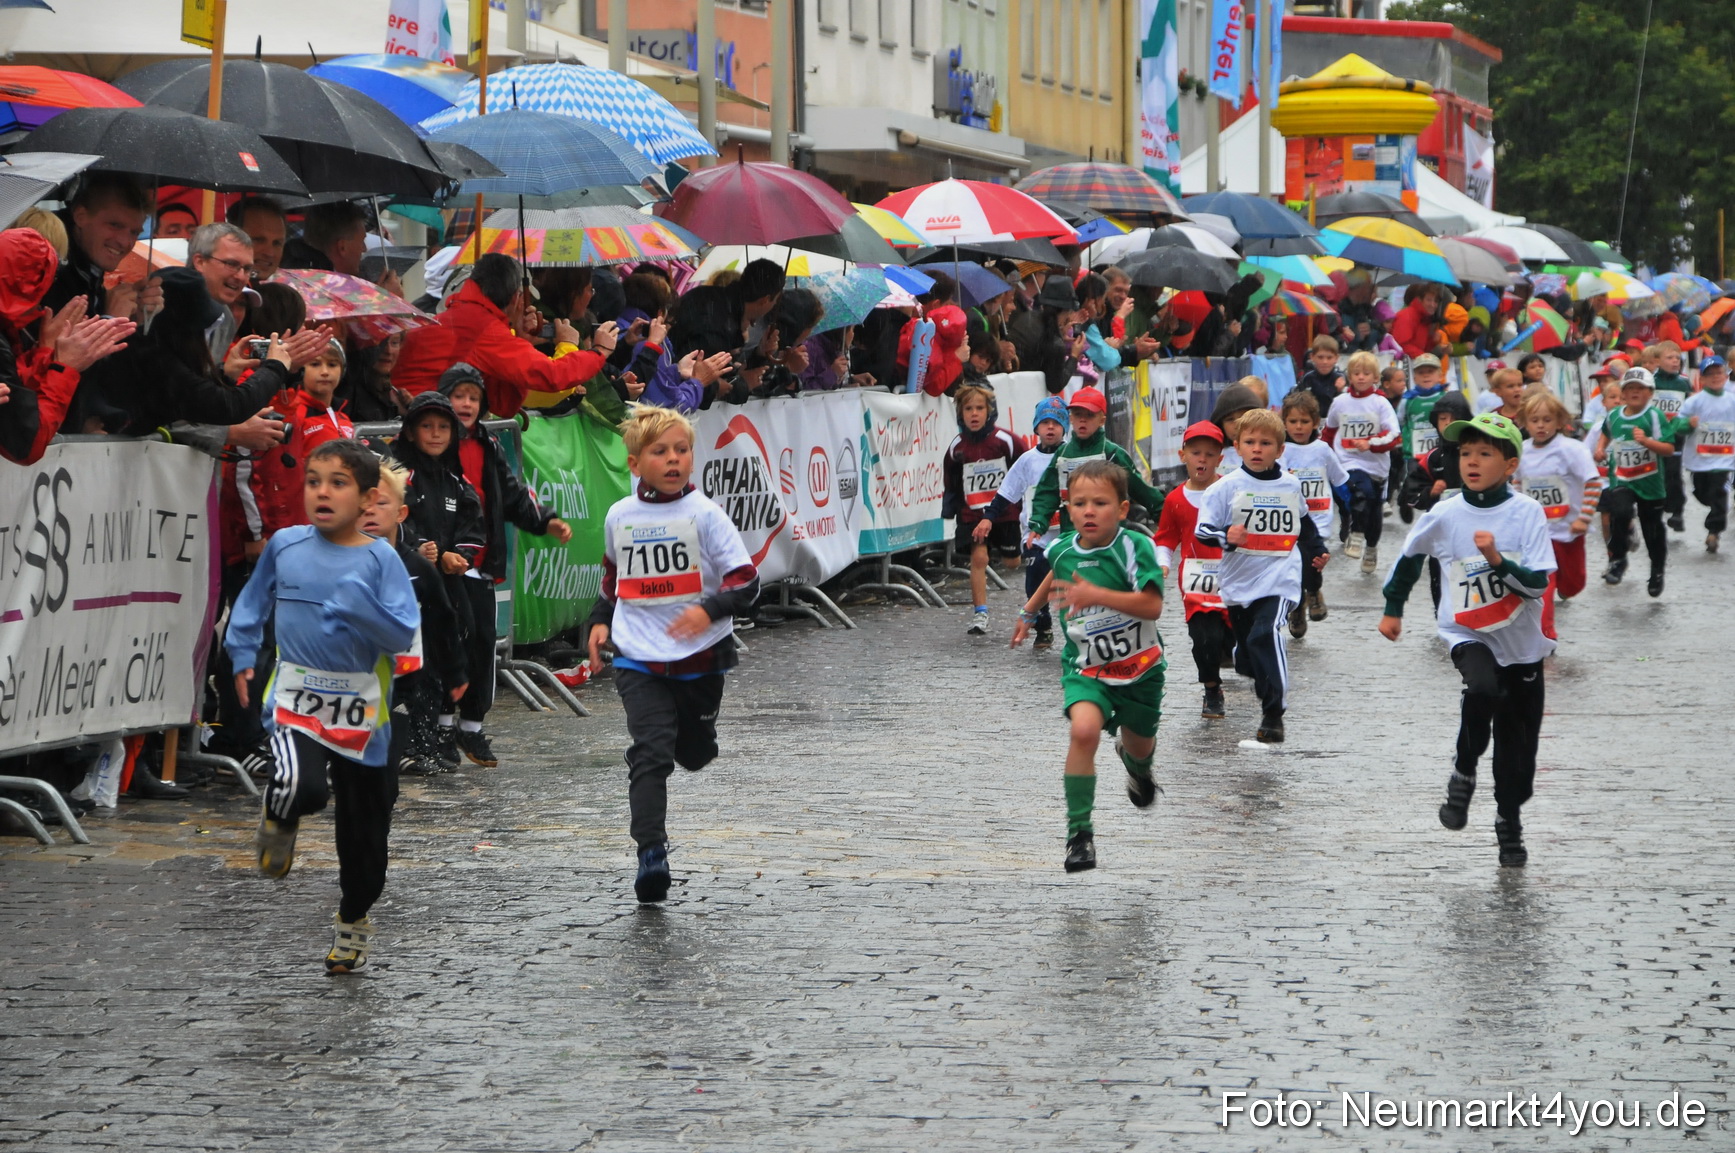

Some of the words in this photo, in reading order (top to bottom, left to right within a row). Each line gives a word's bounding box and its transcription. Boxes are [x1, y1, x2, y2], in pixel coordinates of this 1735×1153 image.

[926, 215, 961, 224] AVIA
[1343, 423, 1376, 438] 7122
[1702, 431, 1732, 444] 7132
[1301, 480, 1324, 498] 077
[1527, 488, 1562, 505] 250
[1241, 508, 1293, 533] 7309
[622, 541, 689, 575] 7106
[1464, 560, 1491, 573] BOC
[640, 580, 674, 595] Jakob
[1190, 573, 1220, 594] 70
[1459, 571, 1505, 609] 716
[1081, 621, 1143, 666] 7057
[285, 688, 367, 727] 7216
